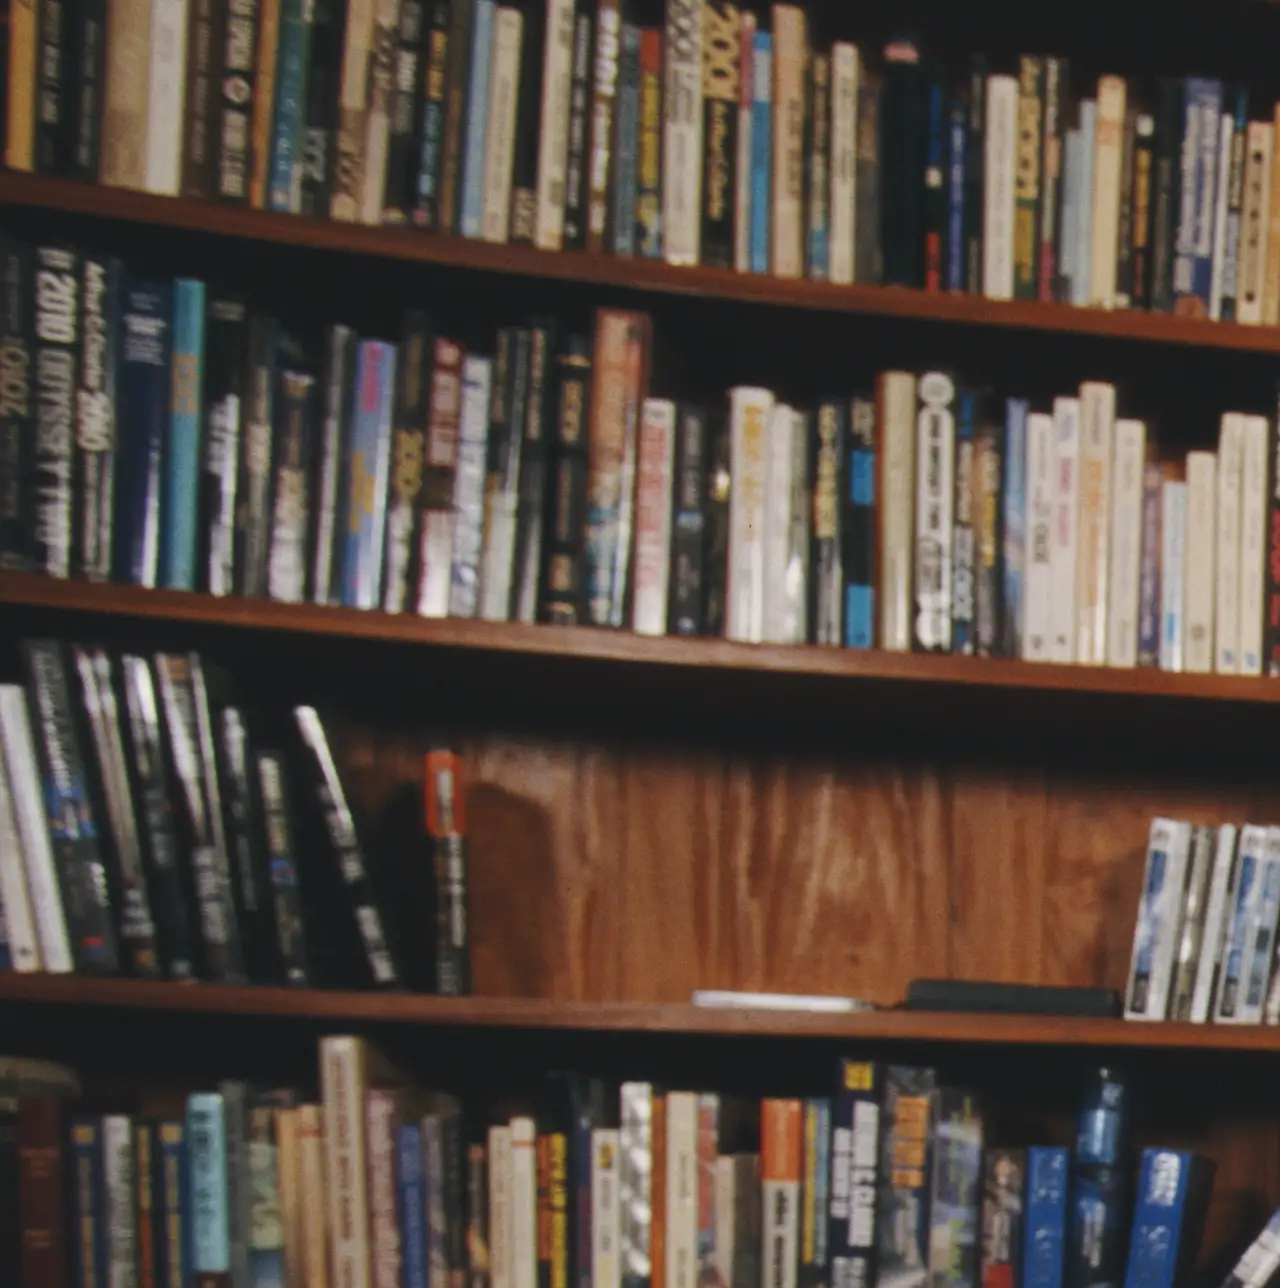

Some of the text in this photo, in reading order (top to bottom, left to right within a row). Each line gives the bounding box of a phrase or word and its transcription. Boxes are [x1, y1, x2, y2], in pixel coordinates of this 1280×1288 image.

[703, 3, 741, 101] 2001
[709, 104, 728, 151] Arthur
[708, 171, 727, 219] Clarke
[36, 271, 76, 343] 2010
[37, 348, 74, 479] ODYSSEY
